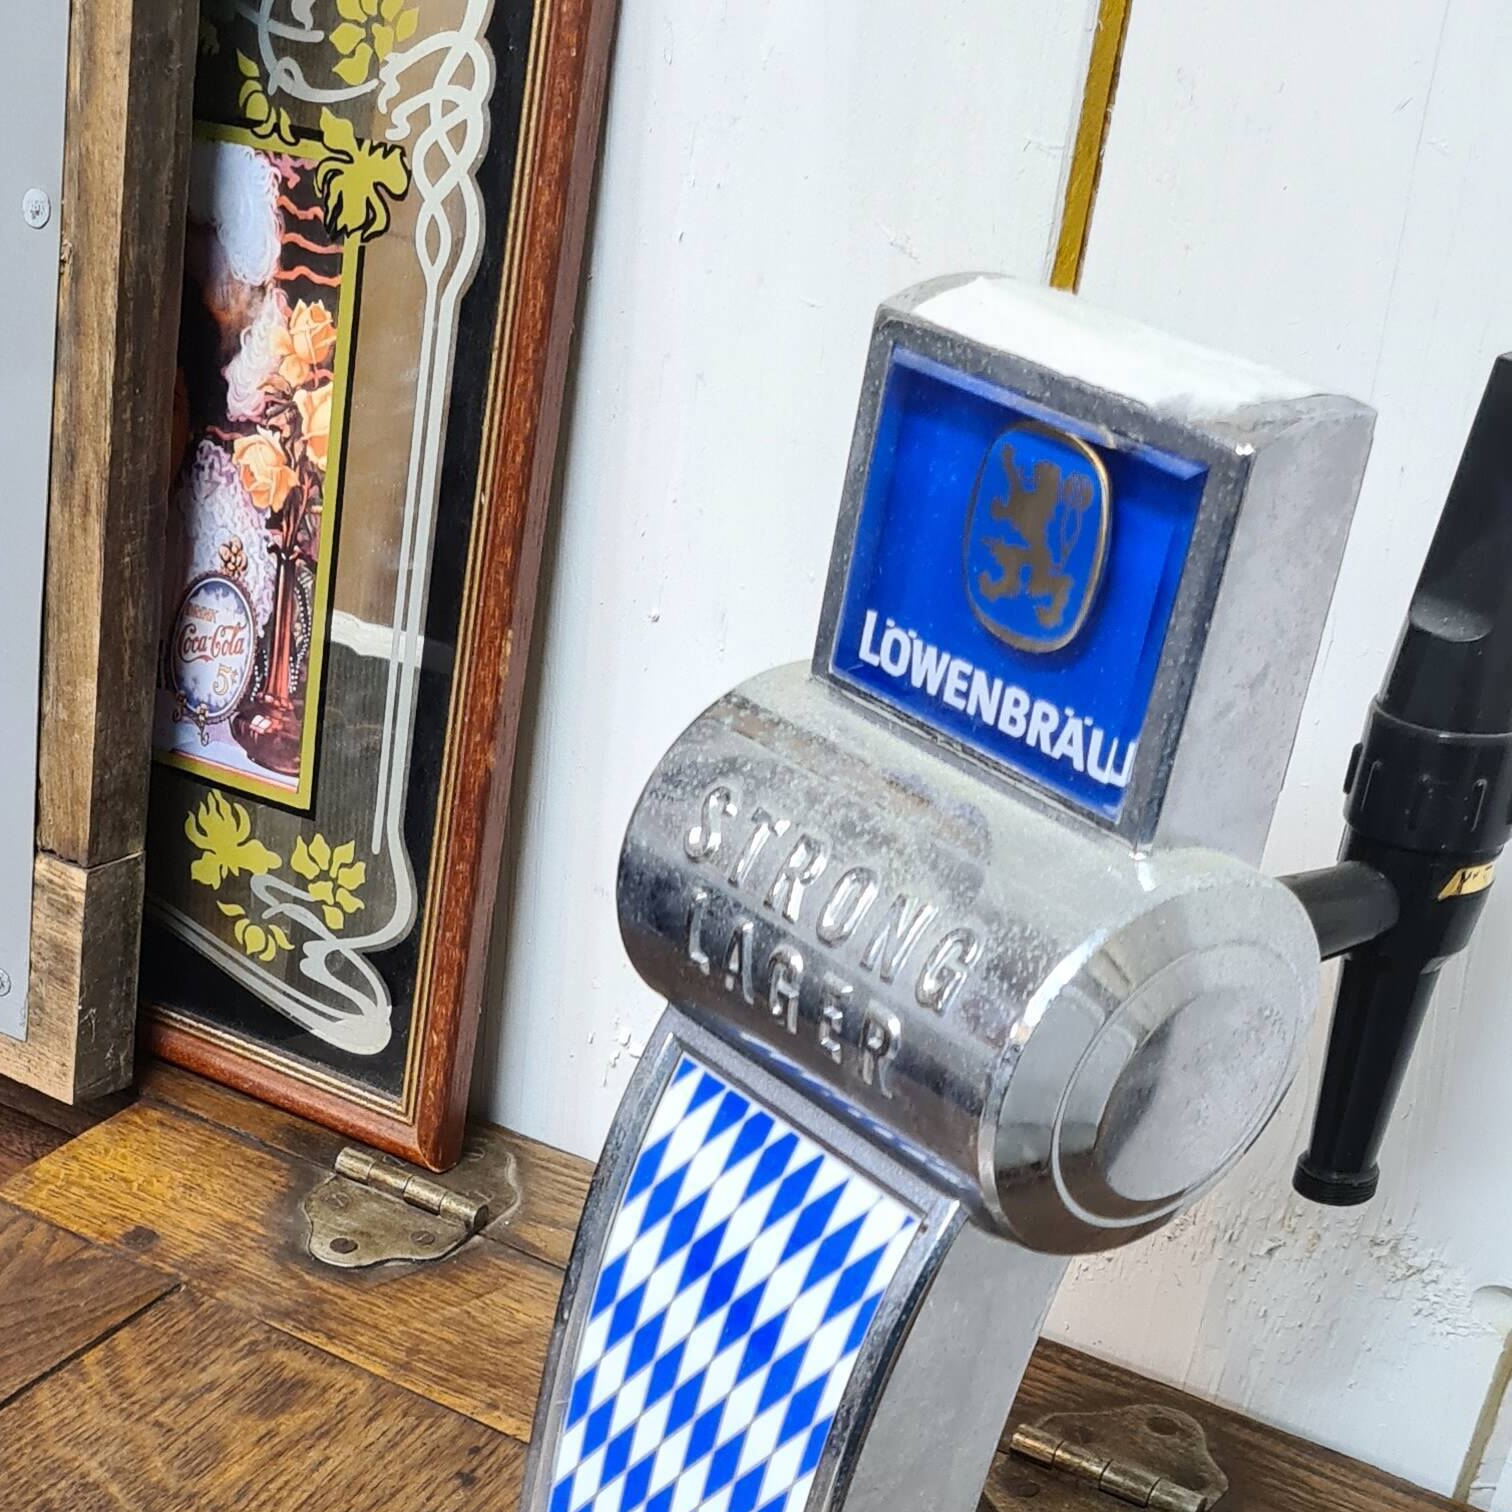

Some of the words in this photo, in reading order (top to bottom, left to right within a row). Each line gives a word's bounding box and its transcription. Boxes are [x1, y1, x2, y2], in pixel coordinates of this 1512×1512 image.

[177, 622, 248, 663] Coca-Cola
[858, 609, 1139, 788] LÖWENBRÄU
[683, 784, 984, 1016] STRONG
[688, 887, 902, 1099] LAGER
